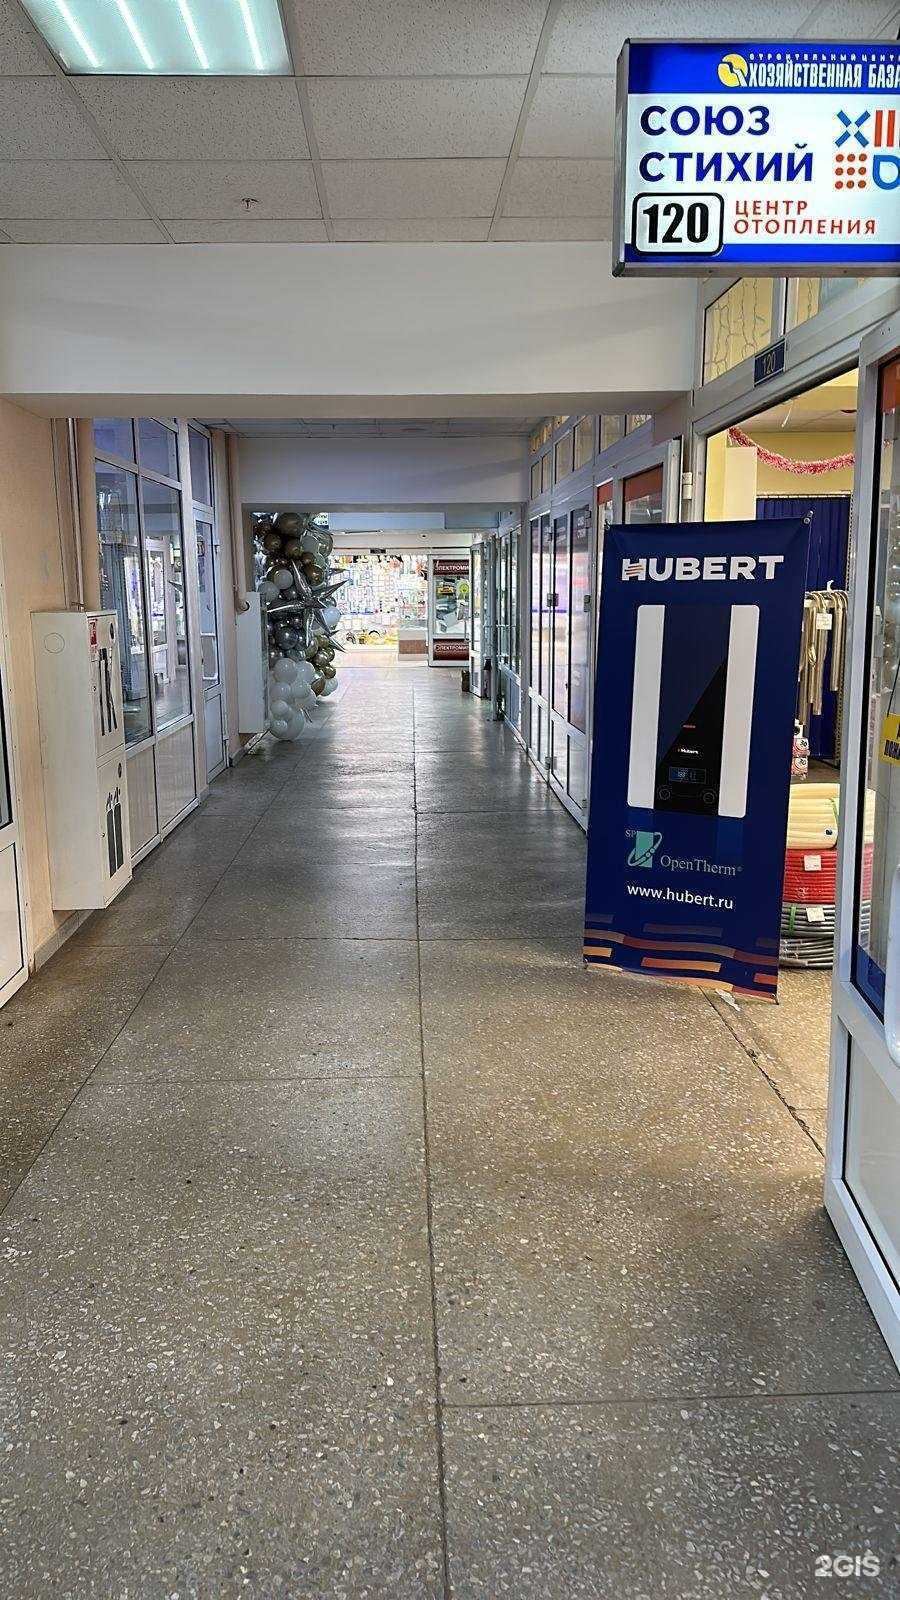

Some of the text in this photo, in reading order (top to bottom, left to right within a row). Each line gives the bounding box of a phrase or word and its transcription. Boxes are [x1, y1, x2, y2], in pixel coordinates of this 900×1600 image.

[861, 53, 900, 62] ЦЕНТ
[749, 60, 863, 88] ХОЗЯЙСТВЕННАЯ
[640, 105, 770, 136] СОЮЗ
[639, 143, 814, 182] СТИХИЙ
[735, 200, 808, 217] ЦЕНТР
[643, 202, 710, 244] 120
[734, 219, 876, 234] ОТОПЛЕНИЯ
[763, 351, 776, 375] 120
[621, 555, 785, 581] HUBERT
[627, 885, 733, 909] www.hubert.ru
